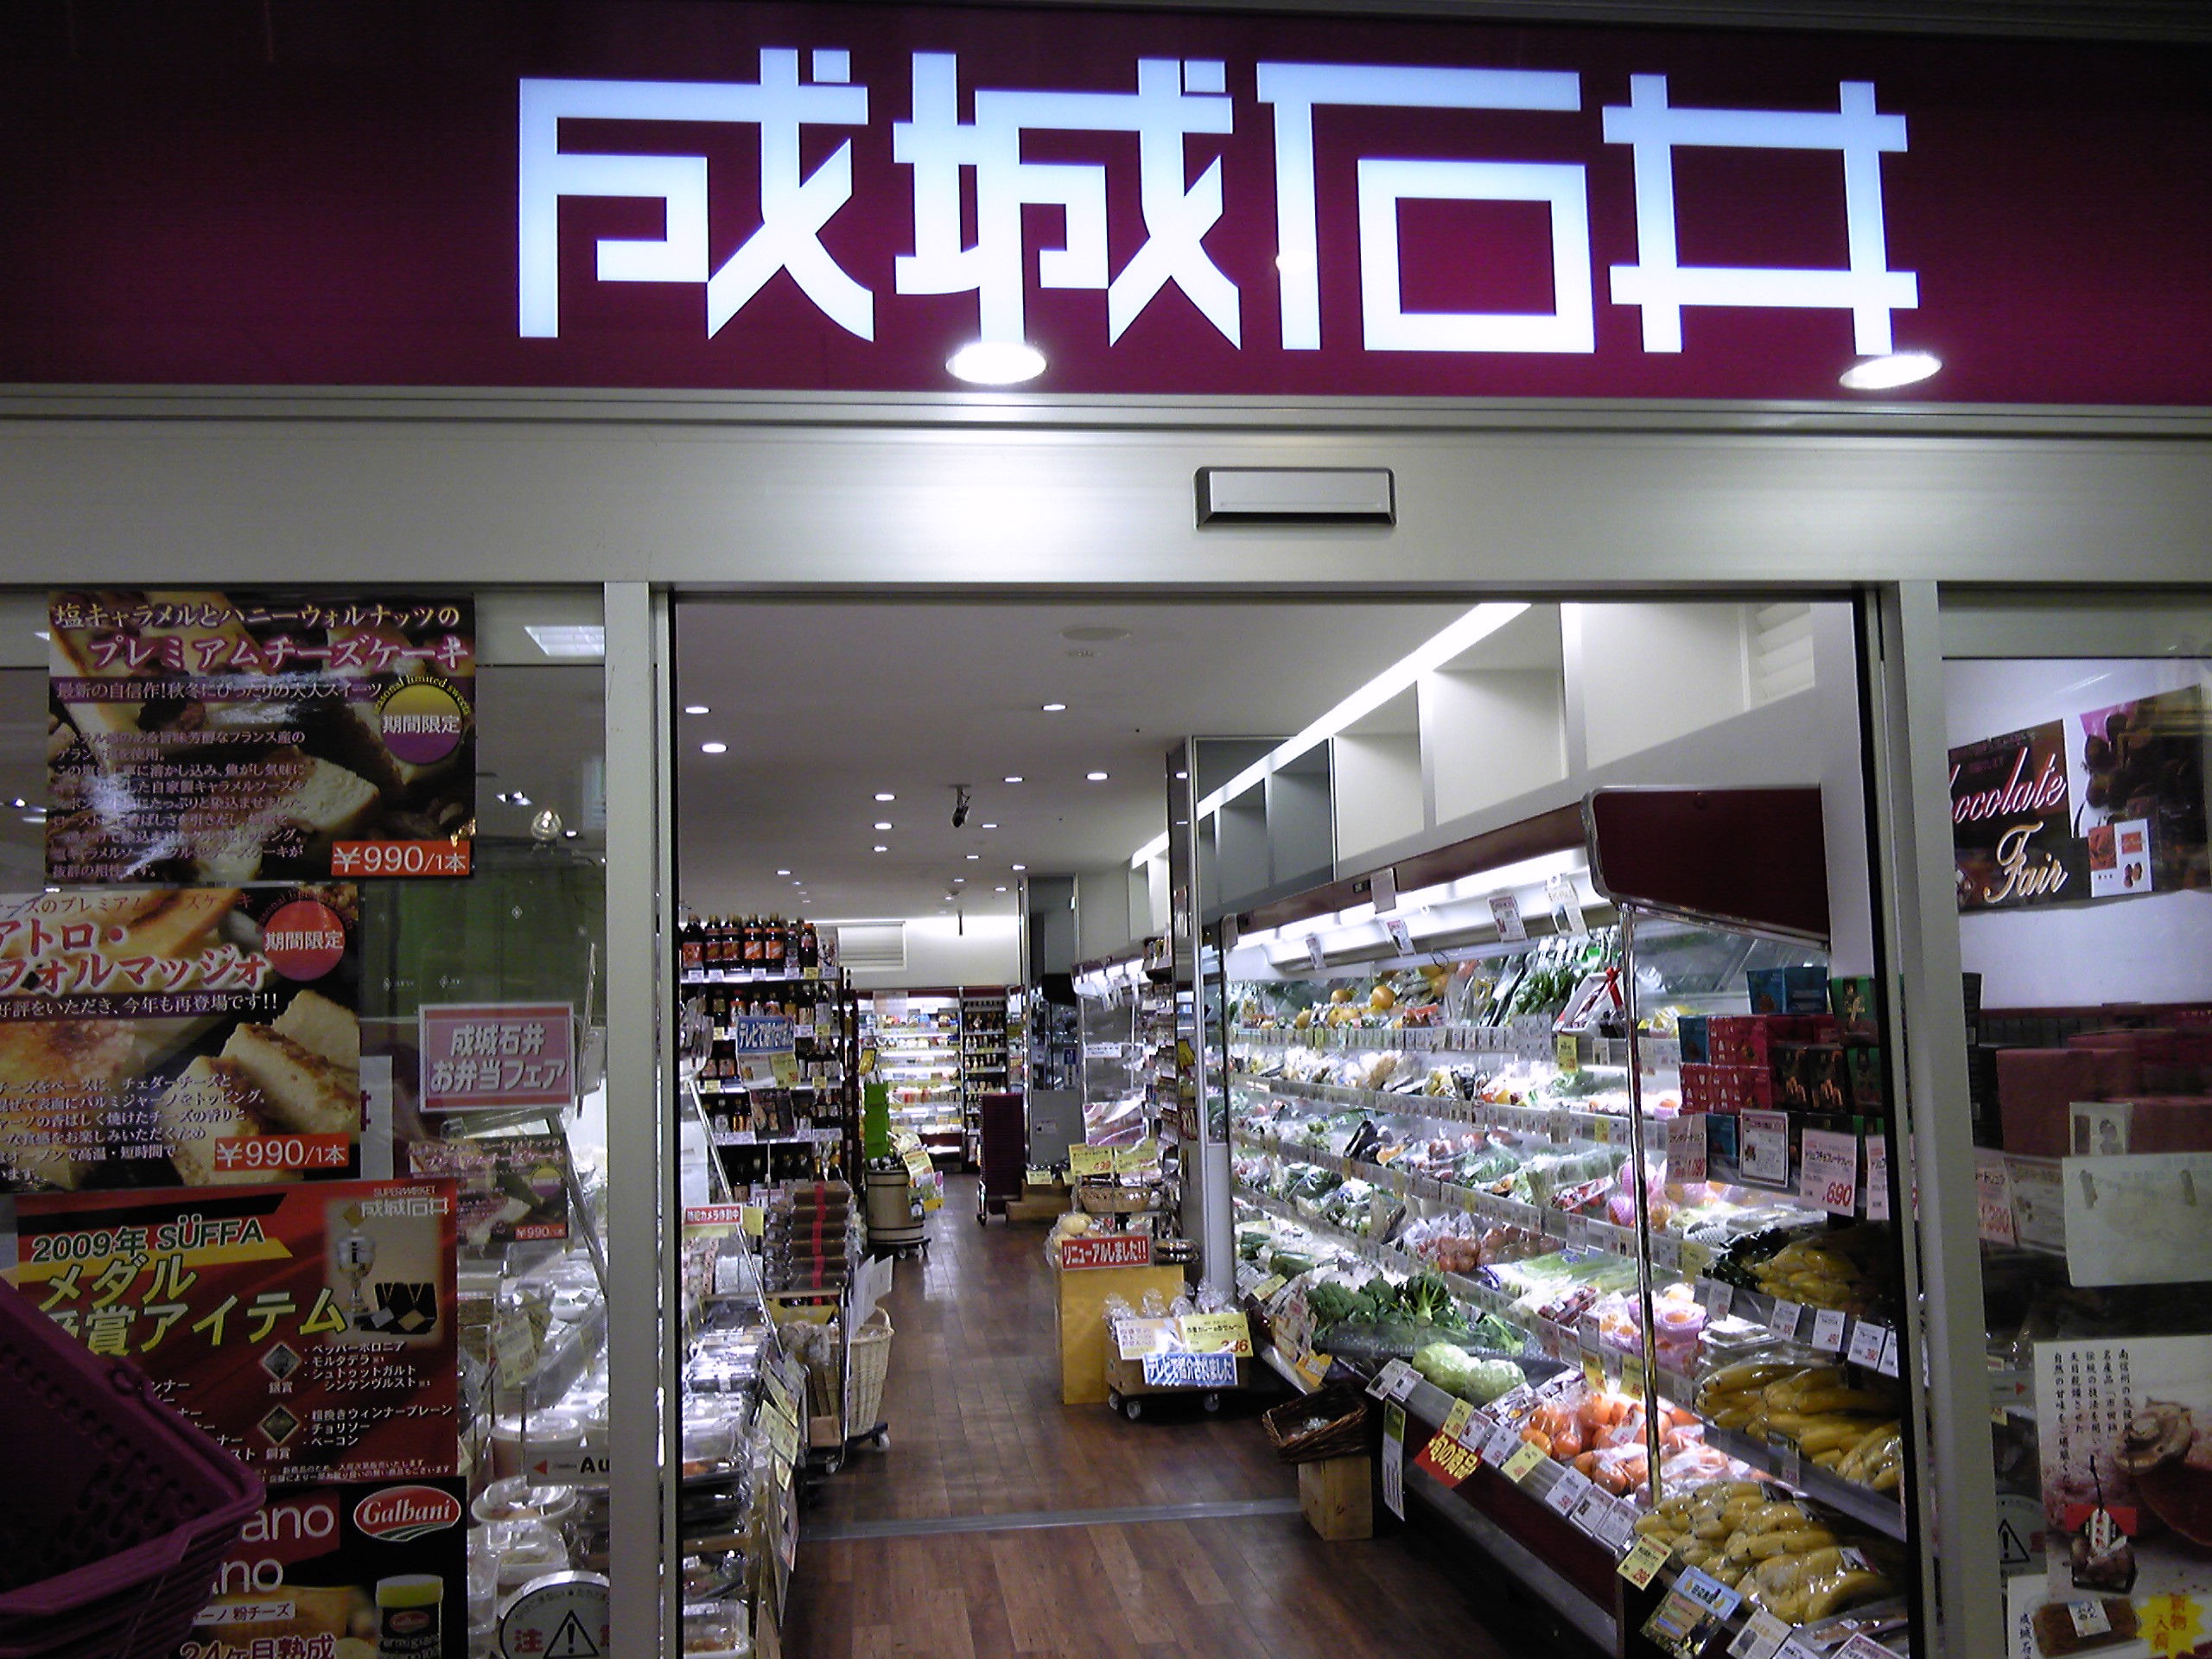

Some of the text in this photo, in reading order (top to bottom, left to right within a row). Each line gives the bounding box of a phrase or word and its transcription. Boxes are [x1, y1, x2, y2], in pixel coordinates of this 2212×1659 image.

[518, 48, 1919, 357] 成城石井
[55, 604, 459, 629] 塩キャラメルとハニーウォルナッツの
[88, 639, 471, 671] プレミアムチーズケーキ
[383, 715, 461, 734] 期間限定
[333, 844, 466, 874] ¥990/1本
[1983, 821, 2069, 903] Fair
[264, 931, 344, 950] 期間限定
[450, 1022, 547, 1056] 成城石井
[430, 1058, 567, 1093] お弁当フェア
[215, 1137, 346, 1168] ¥990/1本
[360, 1197, 449, 1217] 成城石井
[32, 1213, 265, 1262] 2009年 SÜFFA
[1064, 1240, 1147, 1265] リニューアルしました!!
[38, 1253, 198, 1313] メダル
[362, 1496, 452, 1525] Galbani
[213, 1557, 284, 1594] no
